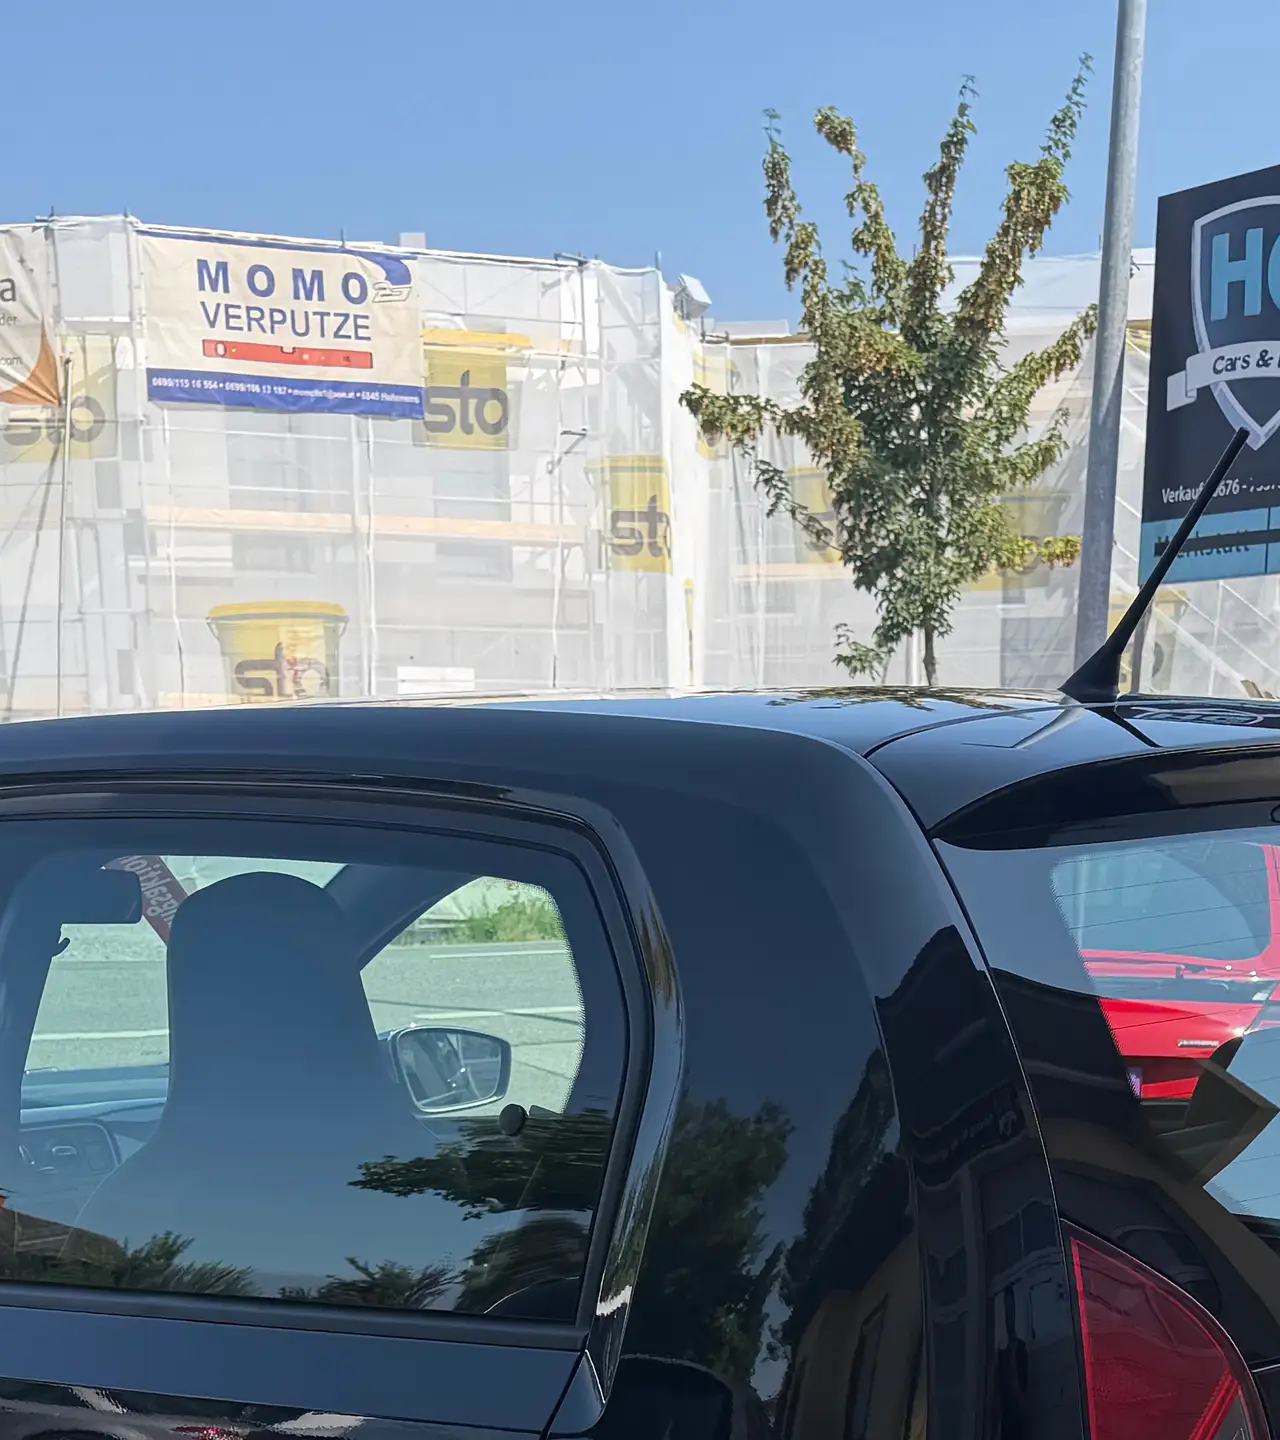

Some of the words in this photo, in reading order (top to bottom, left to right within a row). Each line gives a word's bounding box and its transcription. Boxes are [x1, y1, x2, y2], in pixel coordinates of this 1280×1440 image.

[196, 258, 368, 306] MOMO
[200, 300, 372, 341] VERPUTZE
[1212, 352, 1251, 375] Cars
[1255, 349, 1274, 369] &
[423, 368, 509, 436] sto
[609, 494, 671, 559] st
[234, 641, 330, 698] sto
